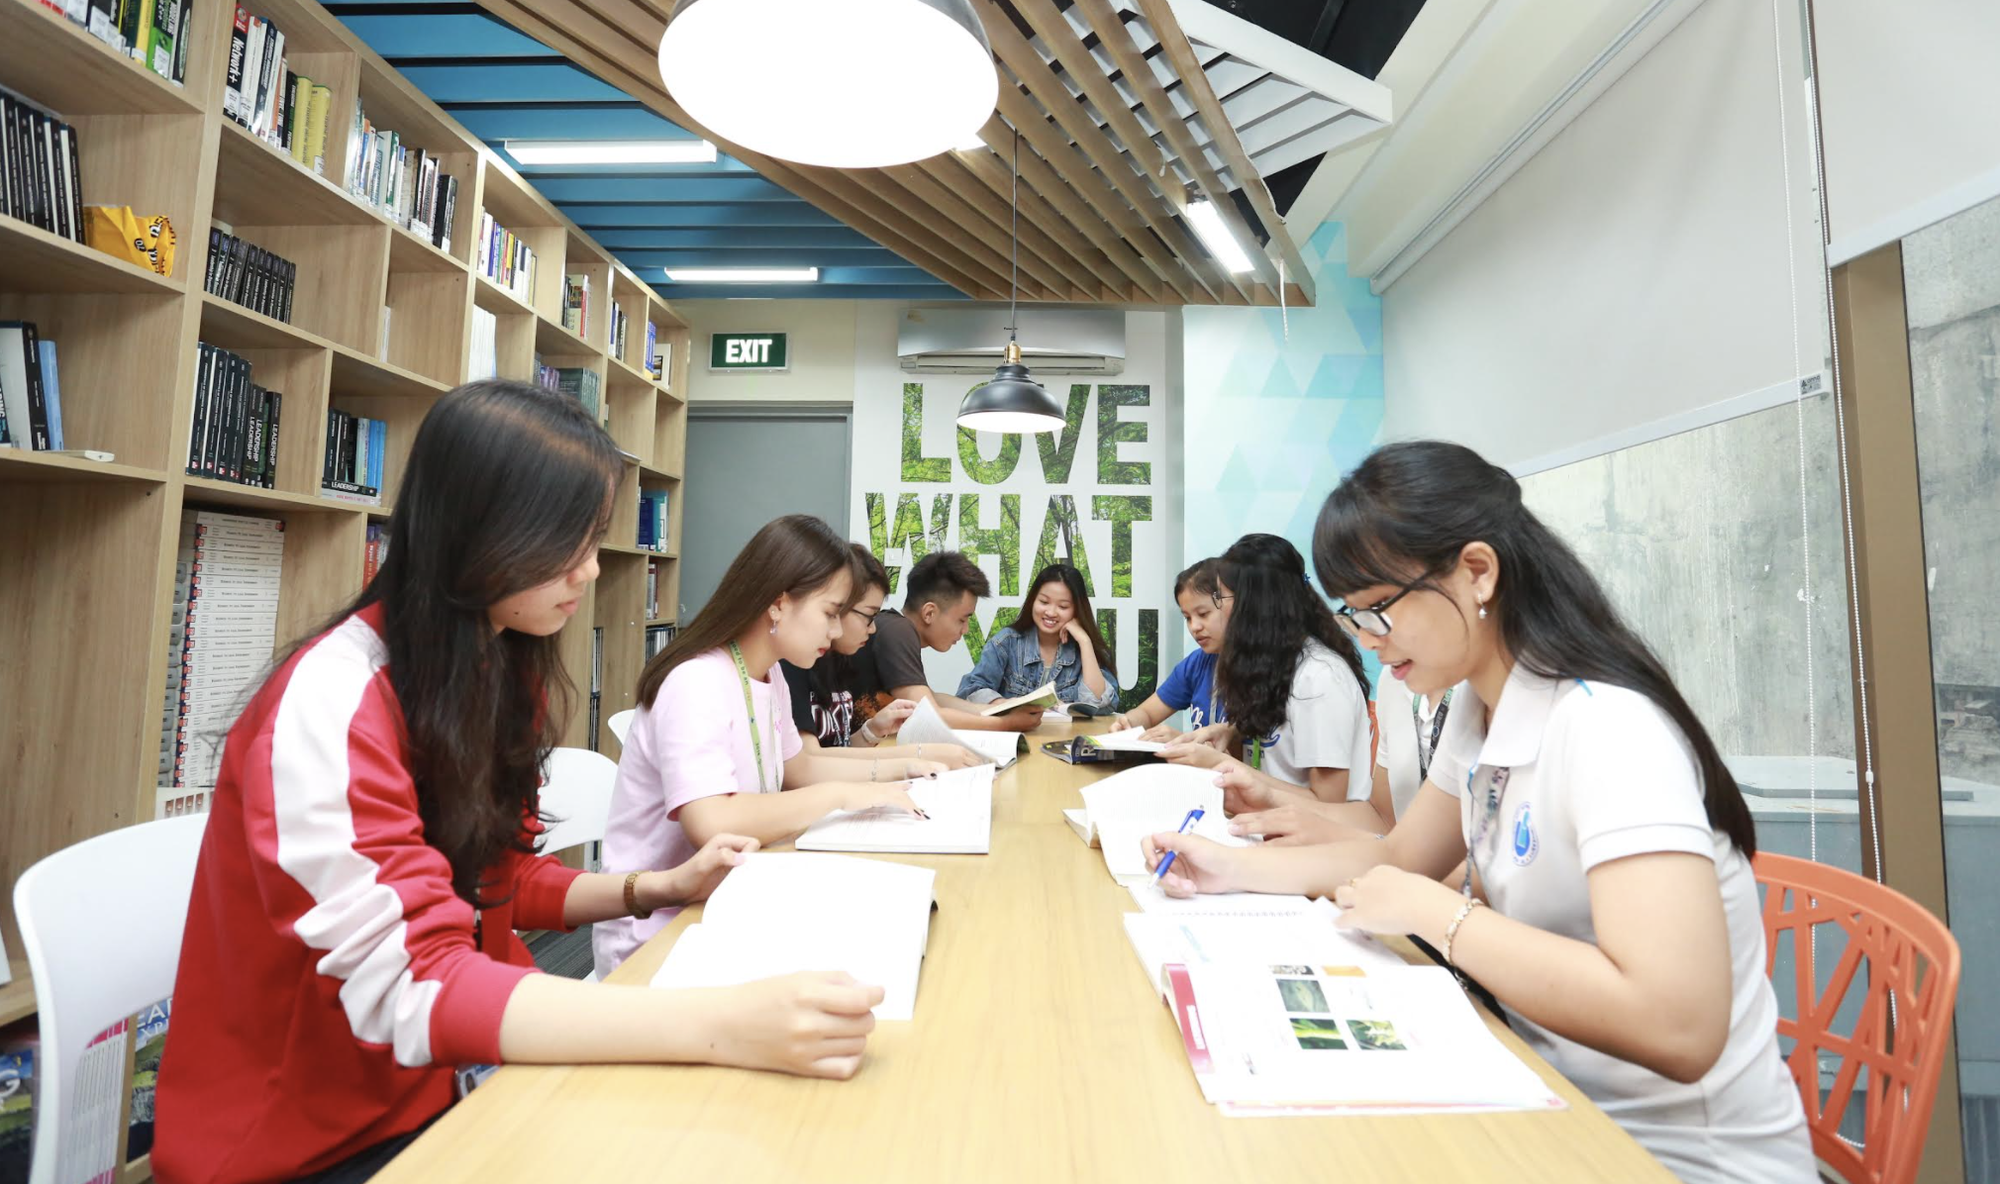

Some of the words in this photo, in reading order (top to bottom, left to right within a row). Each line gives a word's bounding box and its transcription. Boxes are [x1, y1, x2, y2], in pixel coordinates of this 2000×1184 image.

[228, 37, 244, 83] Network+
[725, 338, 773, 363] EXIT
[247, 416, 255, 459] LEADERSHIP
[253, 419, 262, 461] LEADERSHIP
[269, 424, 278, 466] LEADERSHIP
[900, 382, 1152, 485] LOVE
[331, 482, 360, 492] LEADERSHIP
[865, 492, 1153, 598] WHAT
[963, 607, 1159, 714] YU
